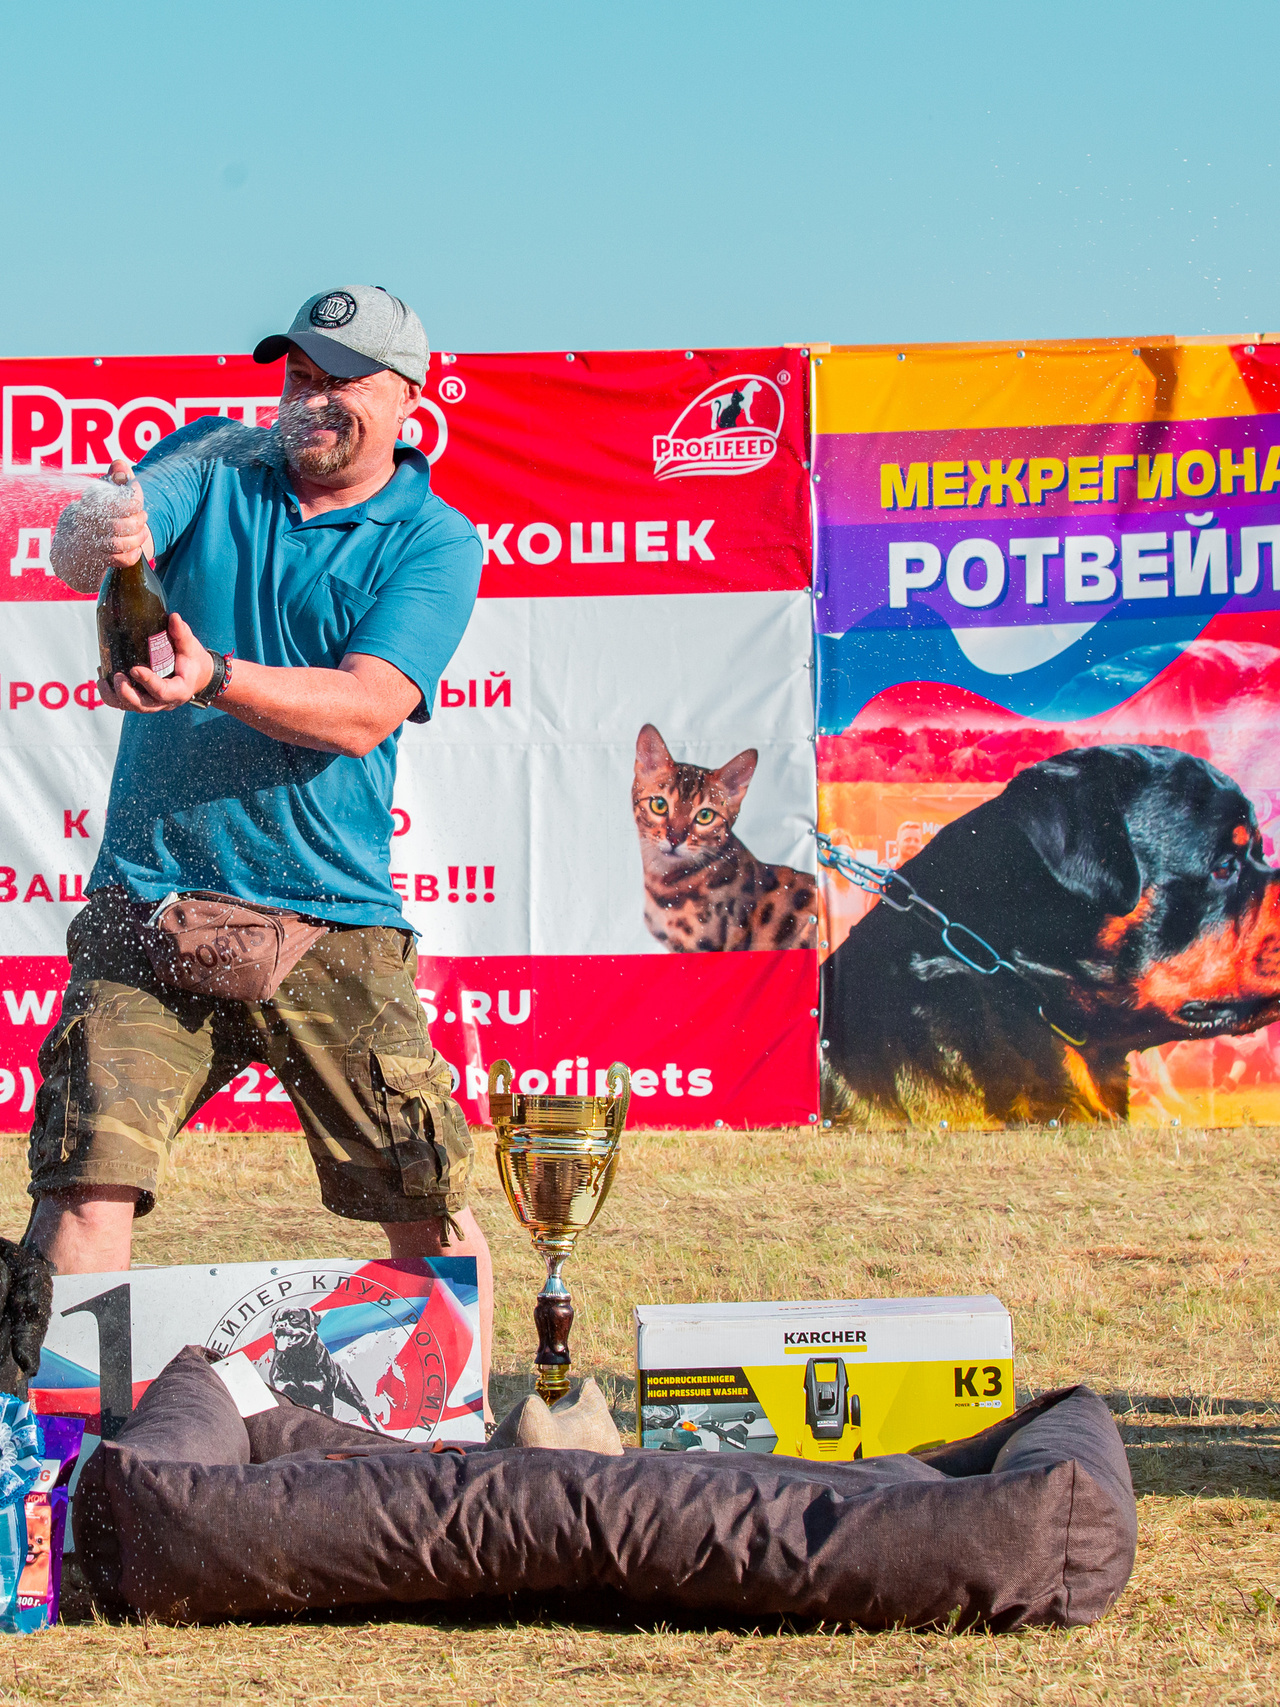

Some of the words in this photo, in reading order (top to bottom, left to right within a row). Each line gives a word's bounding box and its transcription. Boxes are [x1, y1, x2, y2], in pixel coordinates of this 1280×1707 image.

[653, 435, 777, 461] PROFIFEED
[483, 519, 716, 565] КОШЕК
[888, 511, 1280, 608] РОТВЕЙЛ
[450, 1056, 713, 1101] profipets
[312, 1274, 394, 1307] КЛУБ
[401, 1312, 443, 1432] РОССИИ
[784, 1330, 867, 1344] KÄRCHER
[60, 1282, 133, 1441] 1
[647, 1375, 736, 1385] HOCHDRUCKREINIGER
[647, 1390, 668, 1398] HIGH
[669, 1388, 711, 1398] PRESSURE
[713, 1387, 749, 1396] WASHER
